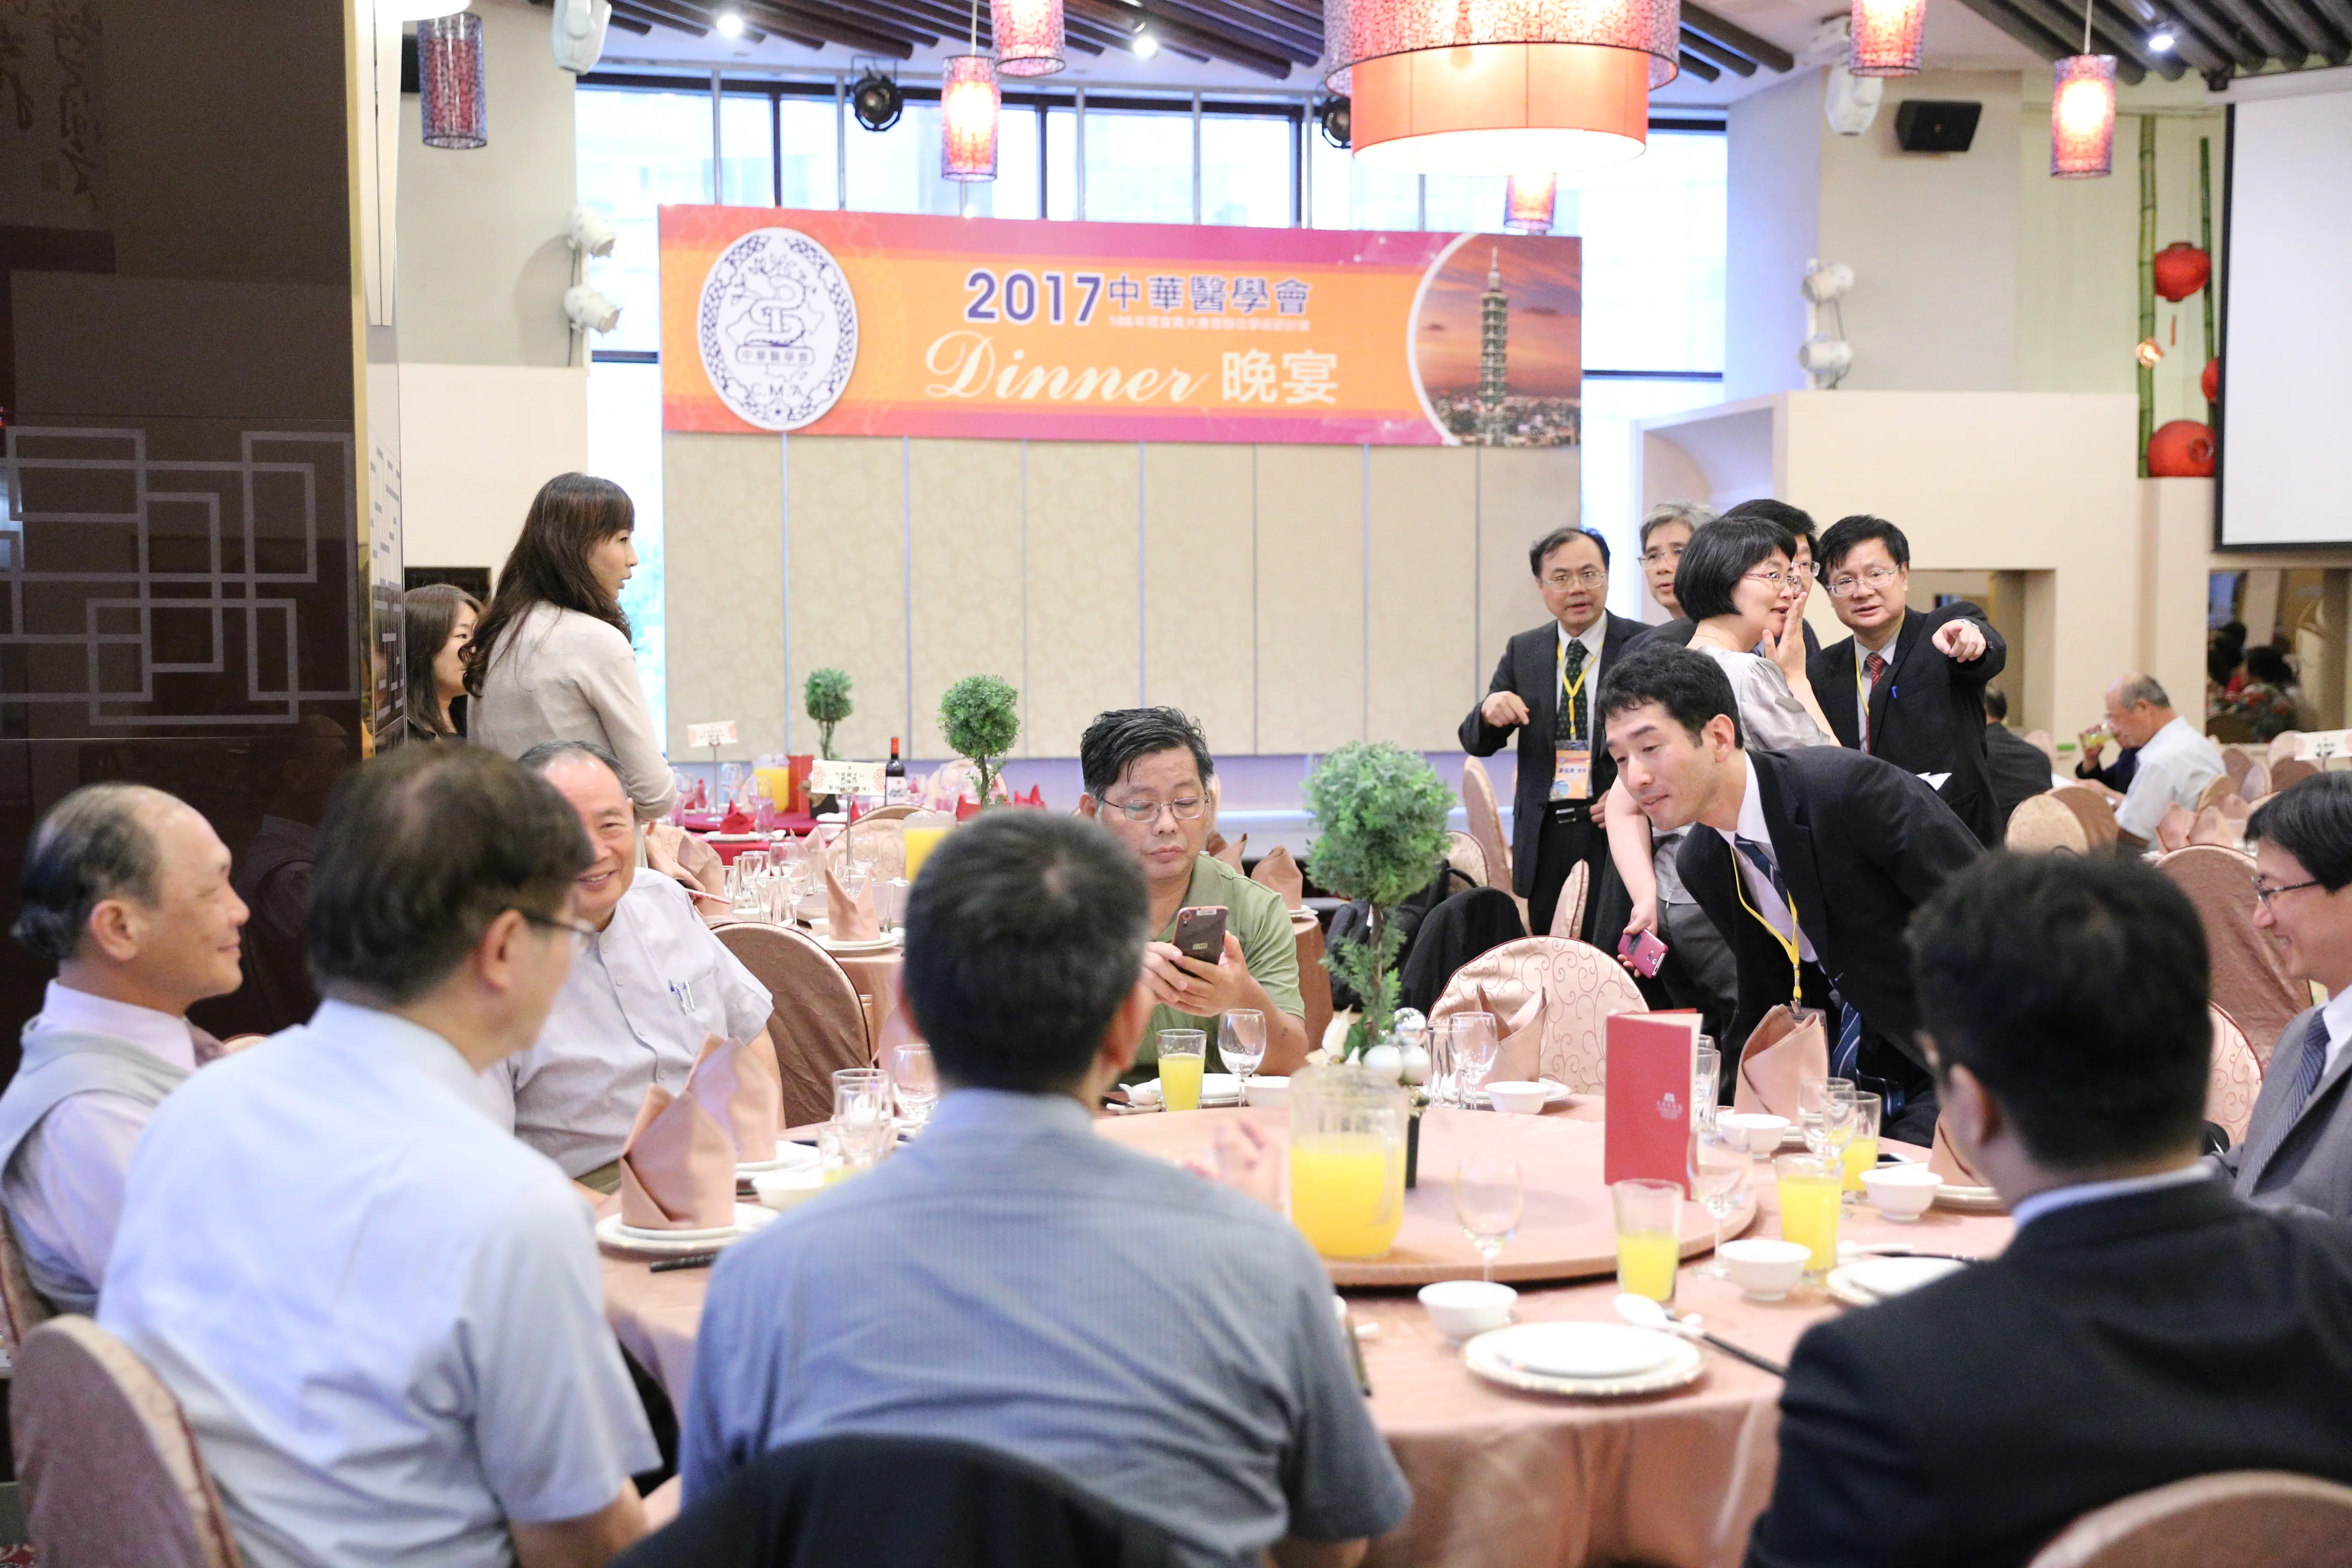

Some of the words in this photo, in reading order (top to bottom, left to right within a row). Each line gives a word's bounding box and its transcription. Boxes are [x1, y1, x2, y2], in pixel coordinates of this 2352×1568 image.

[965, 269, 1103, 325] 2017
[1108, 273, 1312, 315] 中華醫學會
[924, 329, 1209, 403] Dinner
[1222, 347, 1339, 405] 晚宴
